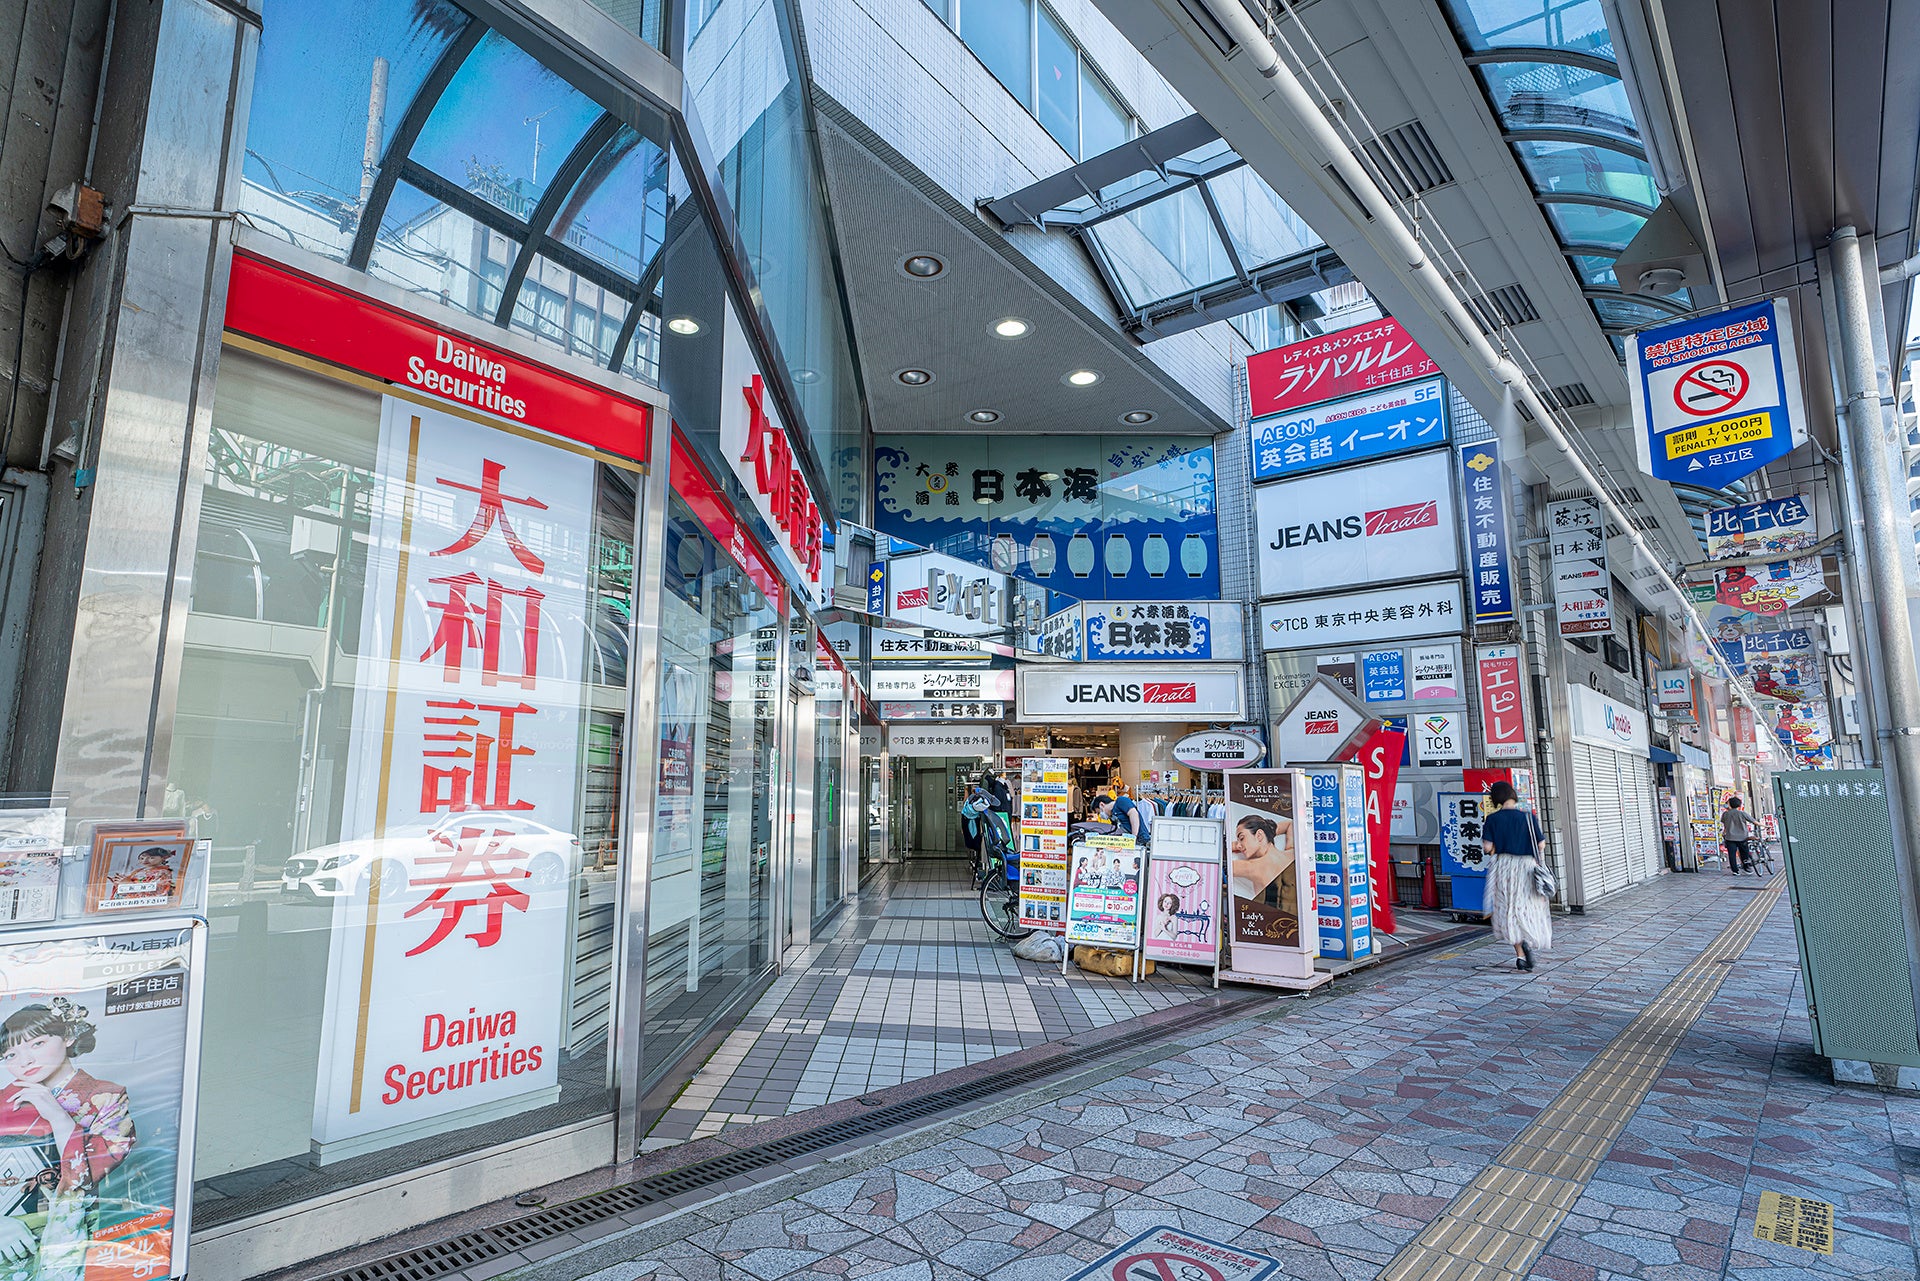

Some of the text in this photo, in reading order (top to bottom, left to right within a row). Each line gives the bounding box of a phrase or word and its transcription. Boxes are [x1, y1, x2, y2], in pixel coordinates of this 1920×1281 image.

[1284, 324, 1395, 364] レディス&メンズエステ
[1645, 316, 1769, 360] 禁煙特定区域
[435, 335, 506, 384] Daiwa
[1653, 334, 1762, 368] NO SMOKING AREA
[1365, 358, 1435, 386] 北千住店 5F
[407, 356, 526, 418] Securities
[1414, 386, 1438, 402] 5F
[1325, 411, 1348, 423] AEON
[1349, 407, 1368, 418] KIDS
[1261, 419, 1316, 445] AEON
[1672, 416, 1763, 445] 罰則 1,000円
[1260, 417, 1440, 471] 英会話 イーオン
[1675, 437, 1718, 454] PENALTY
[1708, 448, 1754, 467] 足立区
[972, 467, 1099, 504] 日本海
[1270, 500, 1438, 551] JEANS mate
[1712, 499, 1808, 534] 北千住
[1473, 476, 1503, 608] 住友不動産販売
[1554, 539, 1602, 556] 日本海
[1560, 572, 1582, 581] JEANS
[927, 567, 1043, 636] EXCEL 33
[1562, 599, 1606, 613] 大和証券
[1284, 600, 1454, 632] TCB 東京中央美容外科
[1107, 622, 1192, 649] 日本海
[1747, 633, 1810, 650] 北千住
[1332, 656, 1341, 664] 5F
[1368, 651, 1399, 663] AEON
[1488, 649, 1506, 658] 4F
[1368, 665, 1400, 677] 英会話
[1274, 680, 1300, 690] EXCEL
[1366, 678, 1404, 688] イーオン
[1663, 679, 1685, 690] UQ
[933, 690, 970, 698] OUTLET
[1066, 683, 1196, 704] JEANS mate
[1378, 690, 1393, 698] 5F
[1429, 689, 1439, 697] 5F
[404, 458, 548, 959] 大和証券
[951, 703, 998, 718] 日本海
[1486, 669, 1519, 740] エピレ
[1305, 709, 1338, 721] JEANS
[900, 736, 990, 746] TCB 東京中央美容外科
[1426, 736, 1453, 750] TCB
[1213, 761, 1221, 769] 5F
[1243, 783, 1280, 794] PARLER
[1367, 746, 1385, 912] SALE
[1459, 799, 1483, 865] 日本海
[1241, 911, 1264, 923] Lady's
[1242, 928, 1264, 937] Men's
[1357, 938, 1365, 949] 5F
[102, 961, 163, 976] OUTLET
[112, 976, 179, 996] 北千住店
[421, 1007, 517, 1053] Daiwa
[381, 1042, 544, 1106] Securities
[1153, 1238, 1252, 1274] NO SMOKING AREA
[132, 1255, 163, 1279] 5F
